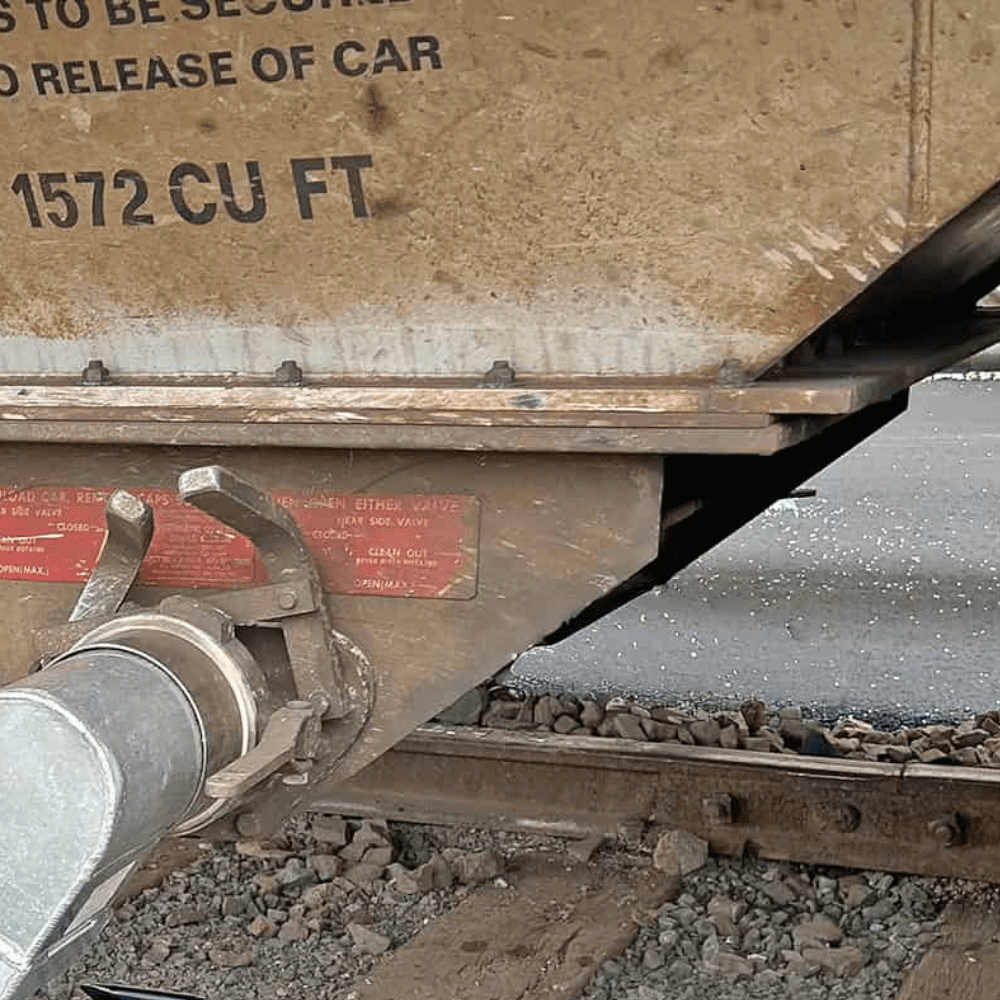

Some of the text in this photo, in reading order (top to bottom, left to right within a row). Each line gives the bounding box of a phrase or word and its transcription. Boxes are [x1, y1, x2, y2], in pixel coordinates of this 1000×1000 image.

[26, 0, 90, 29] TO
[106, 0, 165, 25] BE
[32, 51, 236, 95] RELEASE
[251, 45, 314, 82] OF
[333, 36, 443, 77] CAR
[11, 154, 374, 229] 1572 CU FT
